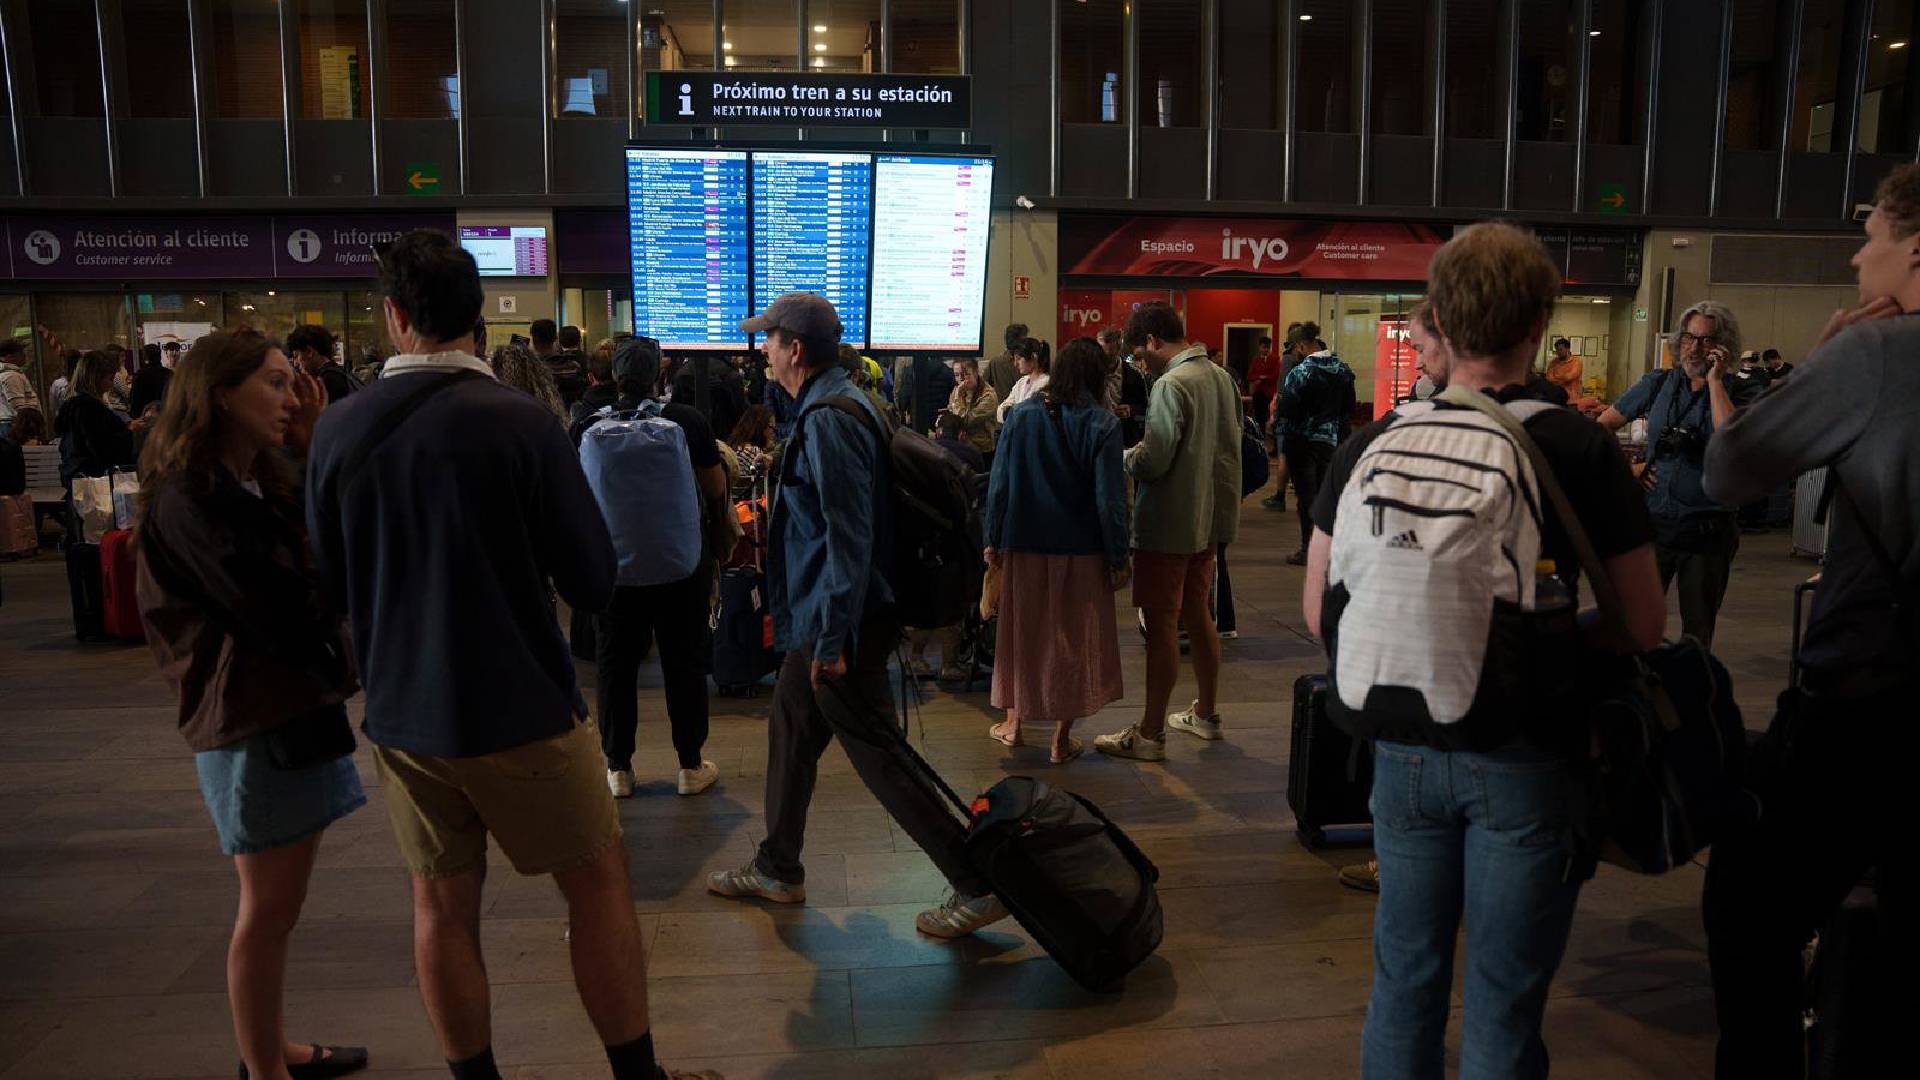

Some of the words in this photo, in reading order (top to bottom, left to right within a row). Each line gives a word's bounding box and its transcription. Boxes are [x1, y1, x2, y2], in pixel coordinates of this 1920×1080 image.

[713, 82, 786, 100] Próximo
[792, 84, 828, 100] tren
[835, 88, 846, 100] a
[852, 88, 872, 101] su
[880, 85, 952, 103] estación
[713, 106, 742, 116] NEXT
[745, 106, 780, 116] TRAIN
[784, 106, 798, 117] TO
[800, 106, 831, 117] YOUR
[834, 107, 882, 118] STATION
[74, 231, 157, 248] Atención
[163, 231, 180, 247] al
[187, 231, 249, 247] cliente
[333, 228, 402, 245] Informa
[1140, 240, 1195, 255] Espacio
[1222, 227, 1289, 270] iryo
[1315, 242, 1349, 251] Atención
[75, 254, 129, 266] Customer
[133, 254, 173, 266] service
[335, 252, 373, 266] Inform
[1323, 252, 1360, 260] Customer
[1063, 304, 1102, 327] iryo
